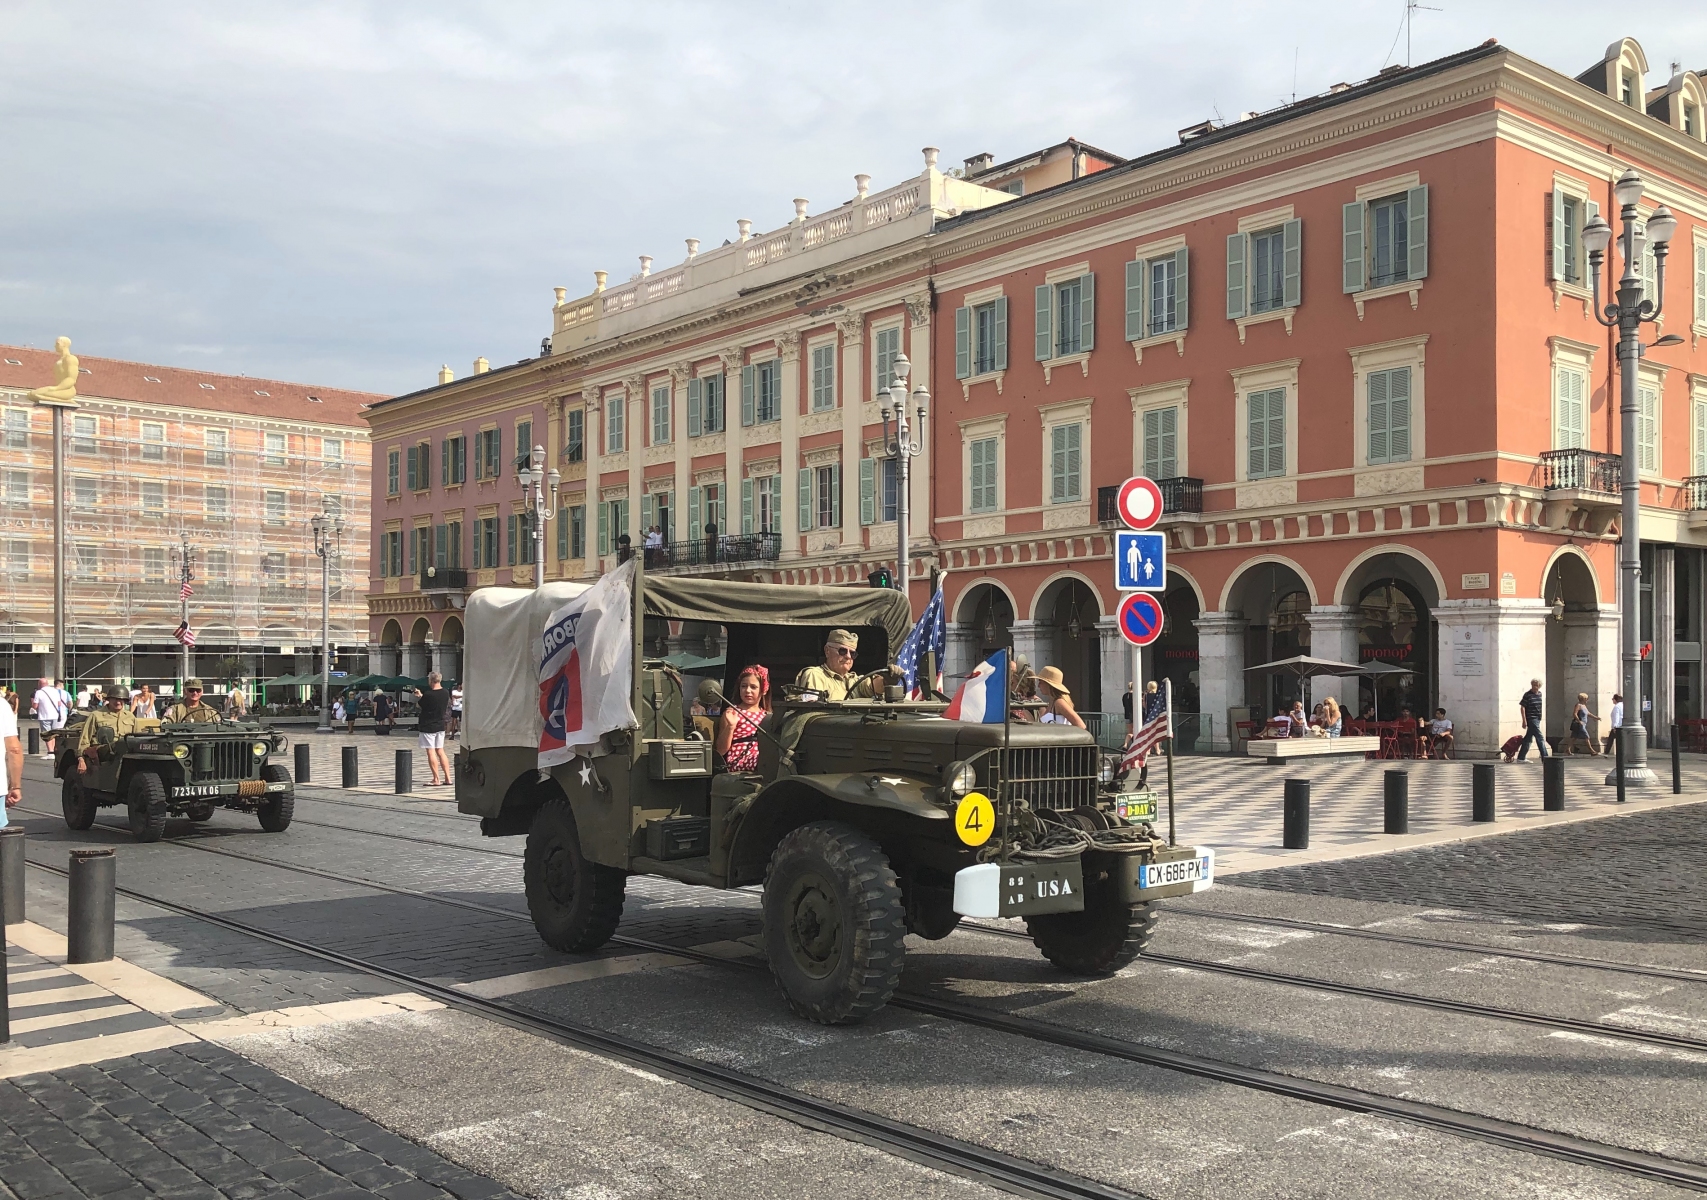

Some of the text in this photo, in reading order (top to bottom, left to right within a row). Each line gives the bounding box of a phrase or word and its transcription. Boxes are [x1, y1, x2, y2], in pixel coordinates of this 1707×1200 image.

[174, 785, 220, 797] 7234 VK 06
[1127, 803, 1149, 817] D-DAY
[964, 805, 983, 832] 4
[1037, 878, 1073, 898] USA
[1008, 893, 1024, 905] AB
